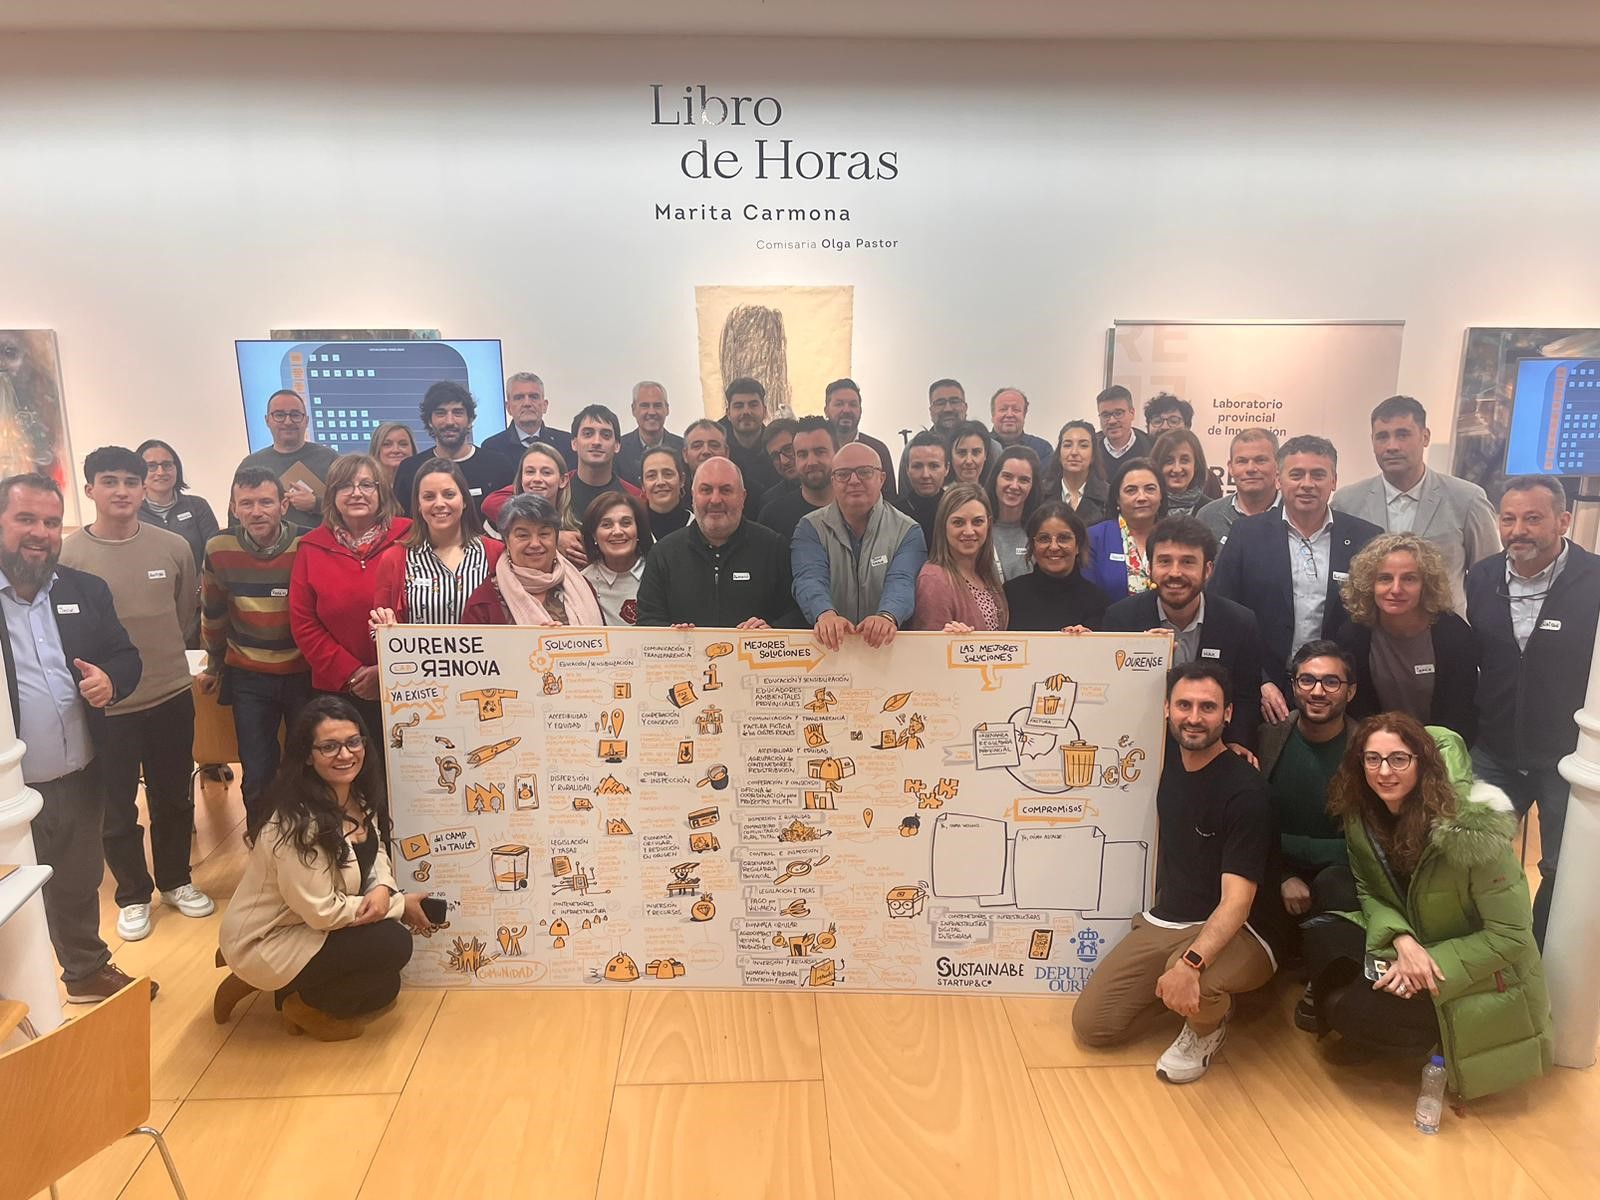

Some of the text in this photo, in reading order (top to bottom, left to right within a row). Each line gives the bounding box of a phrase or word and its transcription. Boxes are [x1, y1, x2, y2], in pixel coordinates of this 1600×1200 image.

[649, 84, 782, 126] Libro
[680, 139, 899, 180] de Horas
[655, 204, 850, 221] Marita Carmona
[756, 238, 899, 251] Comisaria Olga Pastor
[1213, 398, 1283, 409] Laboratorio
[1217, 412, 1275, 424] provincial
[1207, 426, 1222, 436] de
[388, 637, 484, 654] OURENSE
[545, 639, 603, 650] SOLUCIONES
[744, 640, 785, 649] MEJORES
[959, 644, 1019, 653] LAS MEJORES
[759, 649, 811, 659] SOLUCIONES
[964, 653, 1013, 663] SOLUCIONES
[1124, 656, 1163, 668] OURENSE
[391, 688, 439, 701] YA EXISTE
[1022, 804, 1082, 813] COMPROMISOS
[445, 832, 467, 840] CAMP
[447, 839, 476, 851] TAULA
